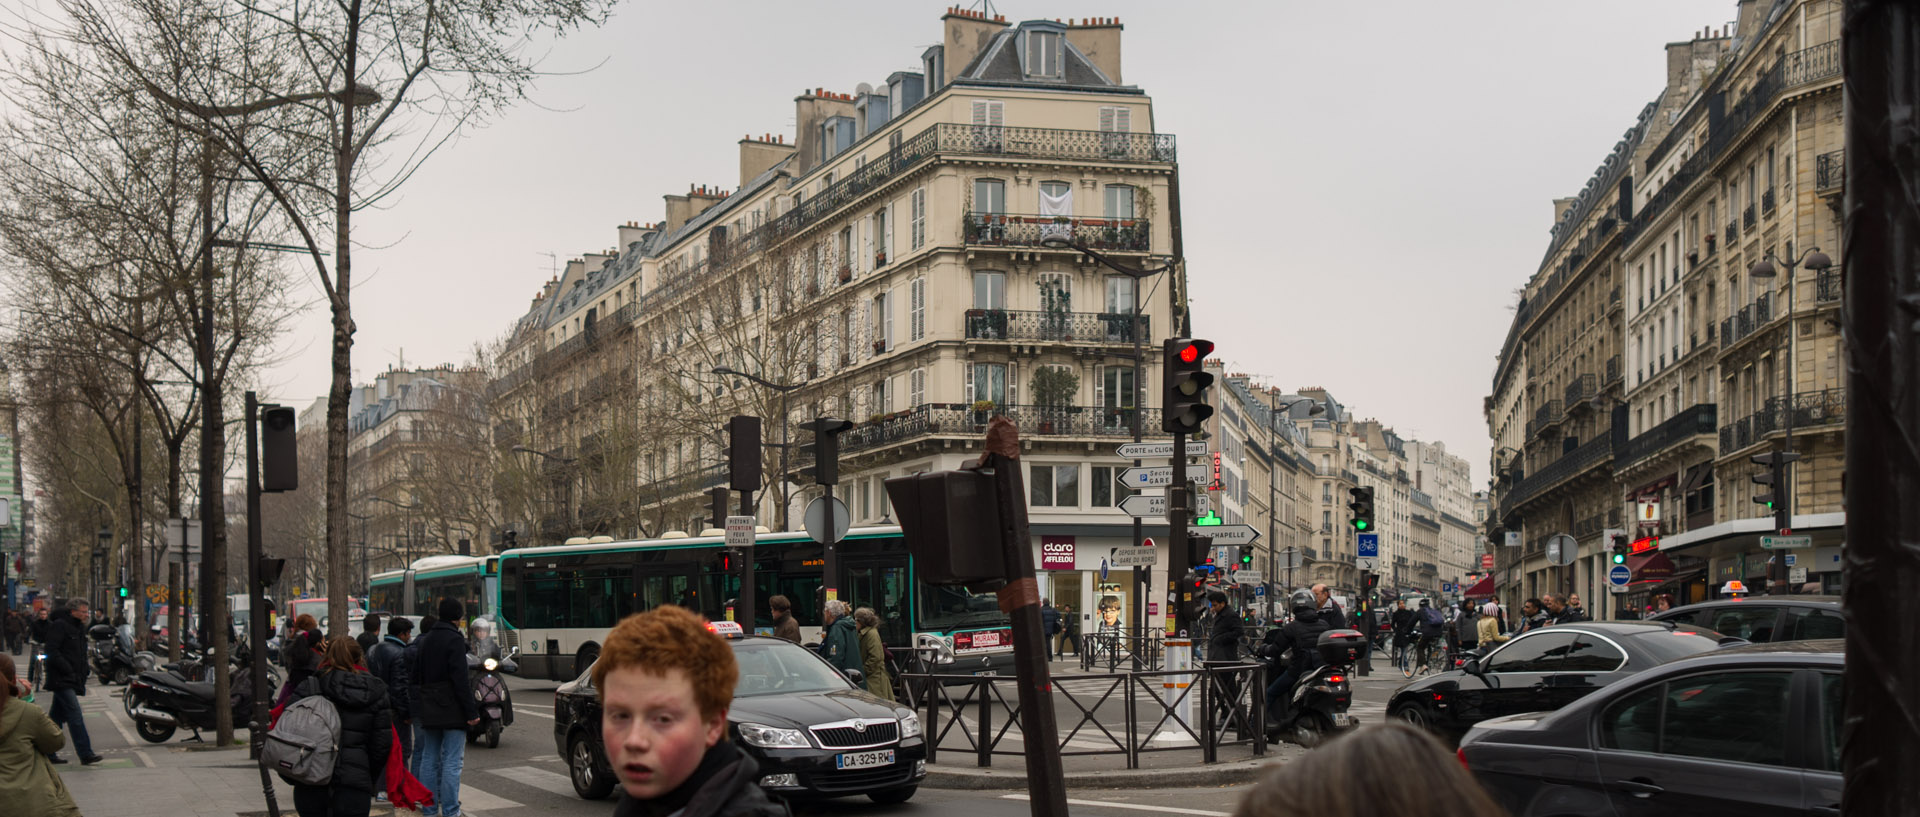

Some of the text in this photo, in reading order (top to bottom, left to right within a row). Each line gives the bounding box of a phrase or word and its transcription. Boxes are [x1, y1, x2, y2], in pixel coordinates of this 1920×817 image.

[1155, 445, 1204, 453] CLIGNOURT
[1043, 542, 1074, 552] claro
[844, 751, 889, 767] CA-329-RW
